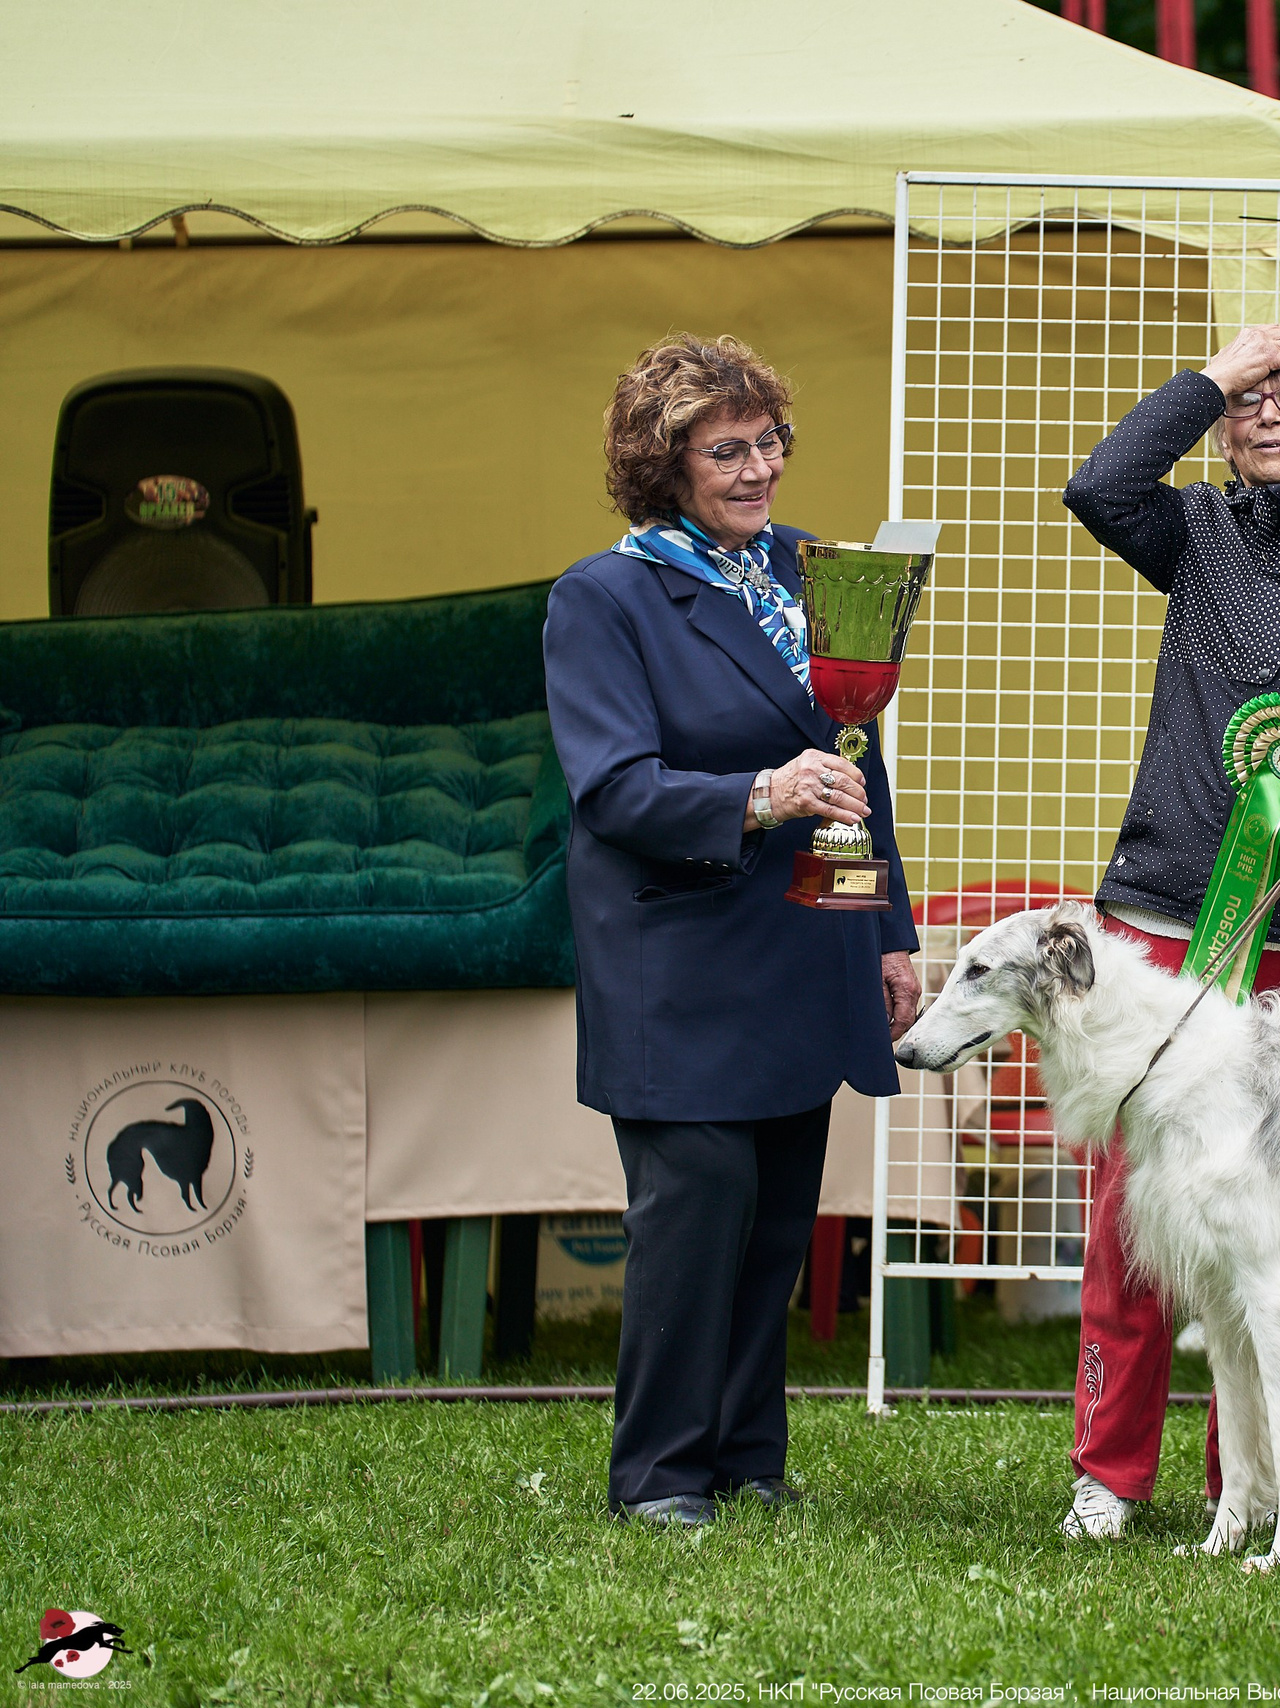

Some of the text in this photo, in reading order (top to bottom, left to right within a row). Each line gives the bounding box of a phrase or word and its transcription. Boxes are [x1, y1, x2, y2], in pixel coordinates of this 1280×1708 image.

[1236, 862, 1254, 874] РПБ
[1239, 853, 1257, 866] НКП
[68, 1061, 252, 1141] НАЦИОНАЛЬНЫЙ КЛУБ ПОРОДЫ
[77, 1198, 248, 1258] Русская Псовая Борзая
